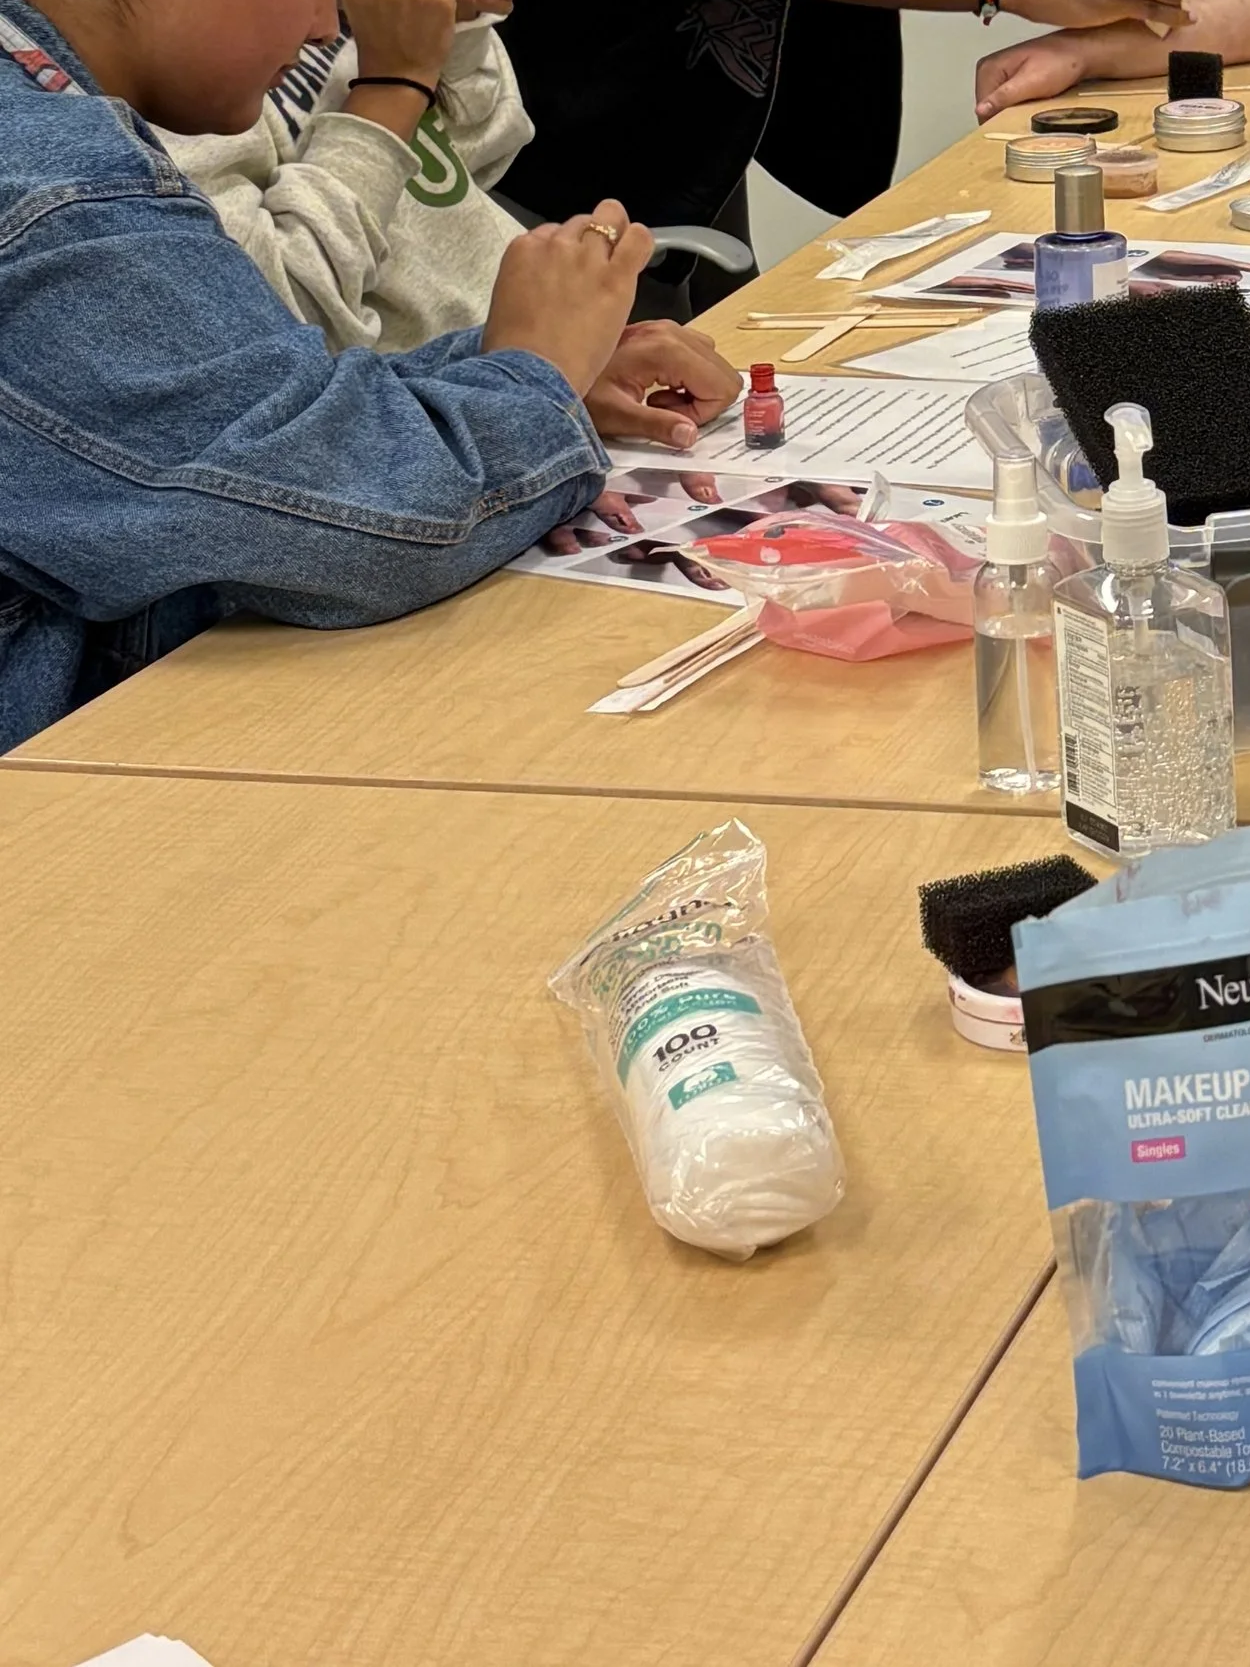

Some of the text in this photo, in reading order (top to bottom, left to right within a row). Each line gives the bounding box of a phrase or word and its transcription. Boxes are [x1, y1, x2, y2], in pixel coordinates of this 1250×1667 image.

[652, 1024, 717, 1062] 100
[659, 1038, 720, 1072] COUNT
[1124, 1068, 1250, 1111] MAKEUP
[1128, 1106, 1212, 1130] ULTRA-SOFT
[1136, 1142, 1180, 1159] Singles
[1192, 1410, 1240, 1422] Technology
[1159, 1425, 1246, 1443] 20 Plant-Based
[1161, 1440, 1233, 1459] Compostable
